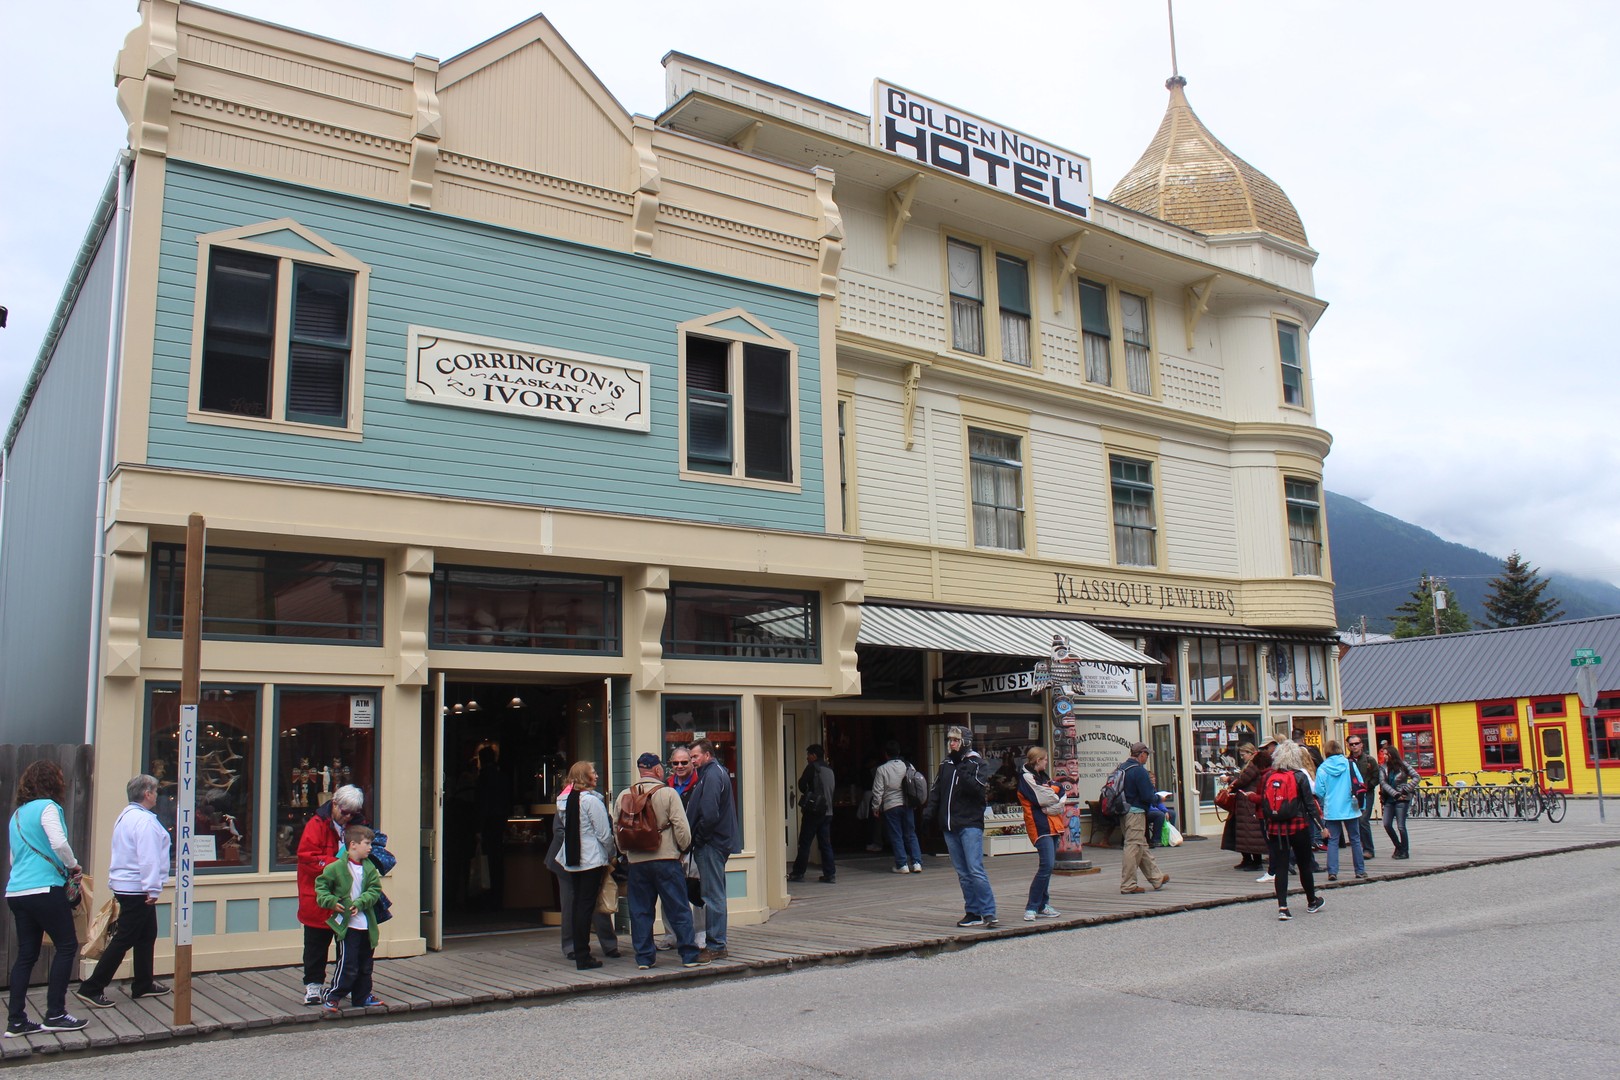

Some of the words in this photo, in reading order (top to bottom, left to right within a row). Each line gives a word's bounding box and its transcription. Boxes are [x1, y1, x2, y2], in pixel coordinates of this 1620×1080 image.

[887, 88, 996, 150] GOLDEN
[1001, 130, 1083, 182] NORTH
[885, 116, 1087, 218] HOTEL
[436, 352, 625, 400] CORRINGTON'S
[489, 373, 579, 393] ALASKAN
[483, 383, 584, 414] IVORY
[1054, 572, 1154, 608] KLASSIQUE
[1159, 586, 1235, 617] JEWELERS
[982, 671, 1035, 693] MUSE
[355, 699, 370, 707] ATM
[1087, 732, 1107, 741] TOUR
[1107, 733, 1134, 749] COMPAN
[1192, 720, 1226, 732] KLASSIQUE
[1304, 735, 1319, 744] FREE
[183, 729, 192, 790] CITY
[181, 810, 190, 920] TRANSIT
